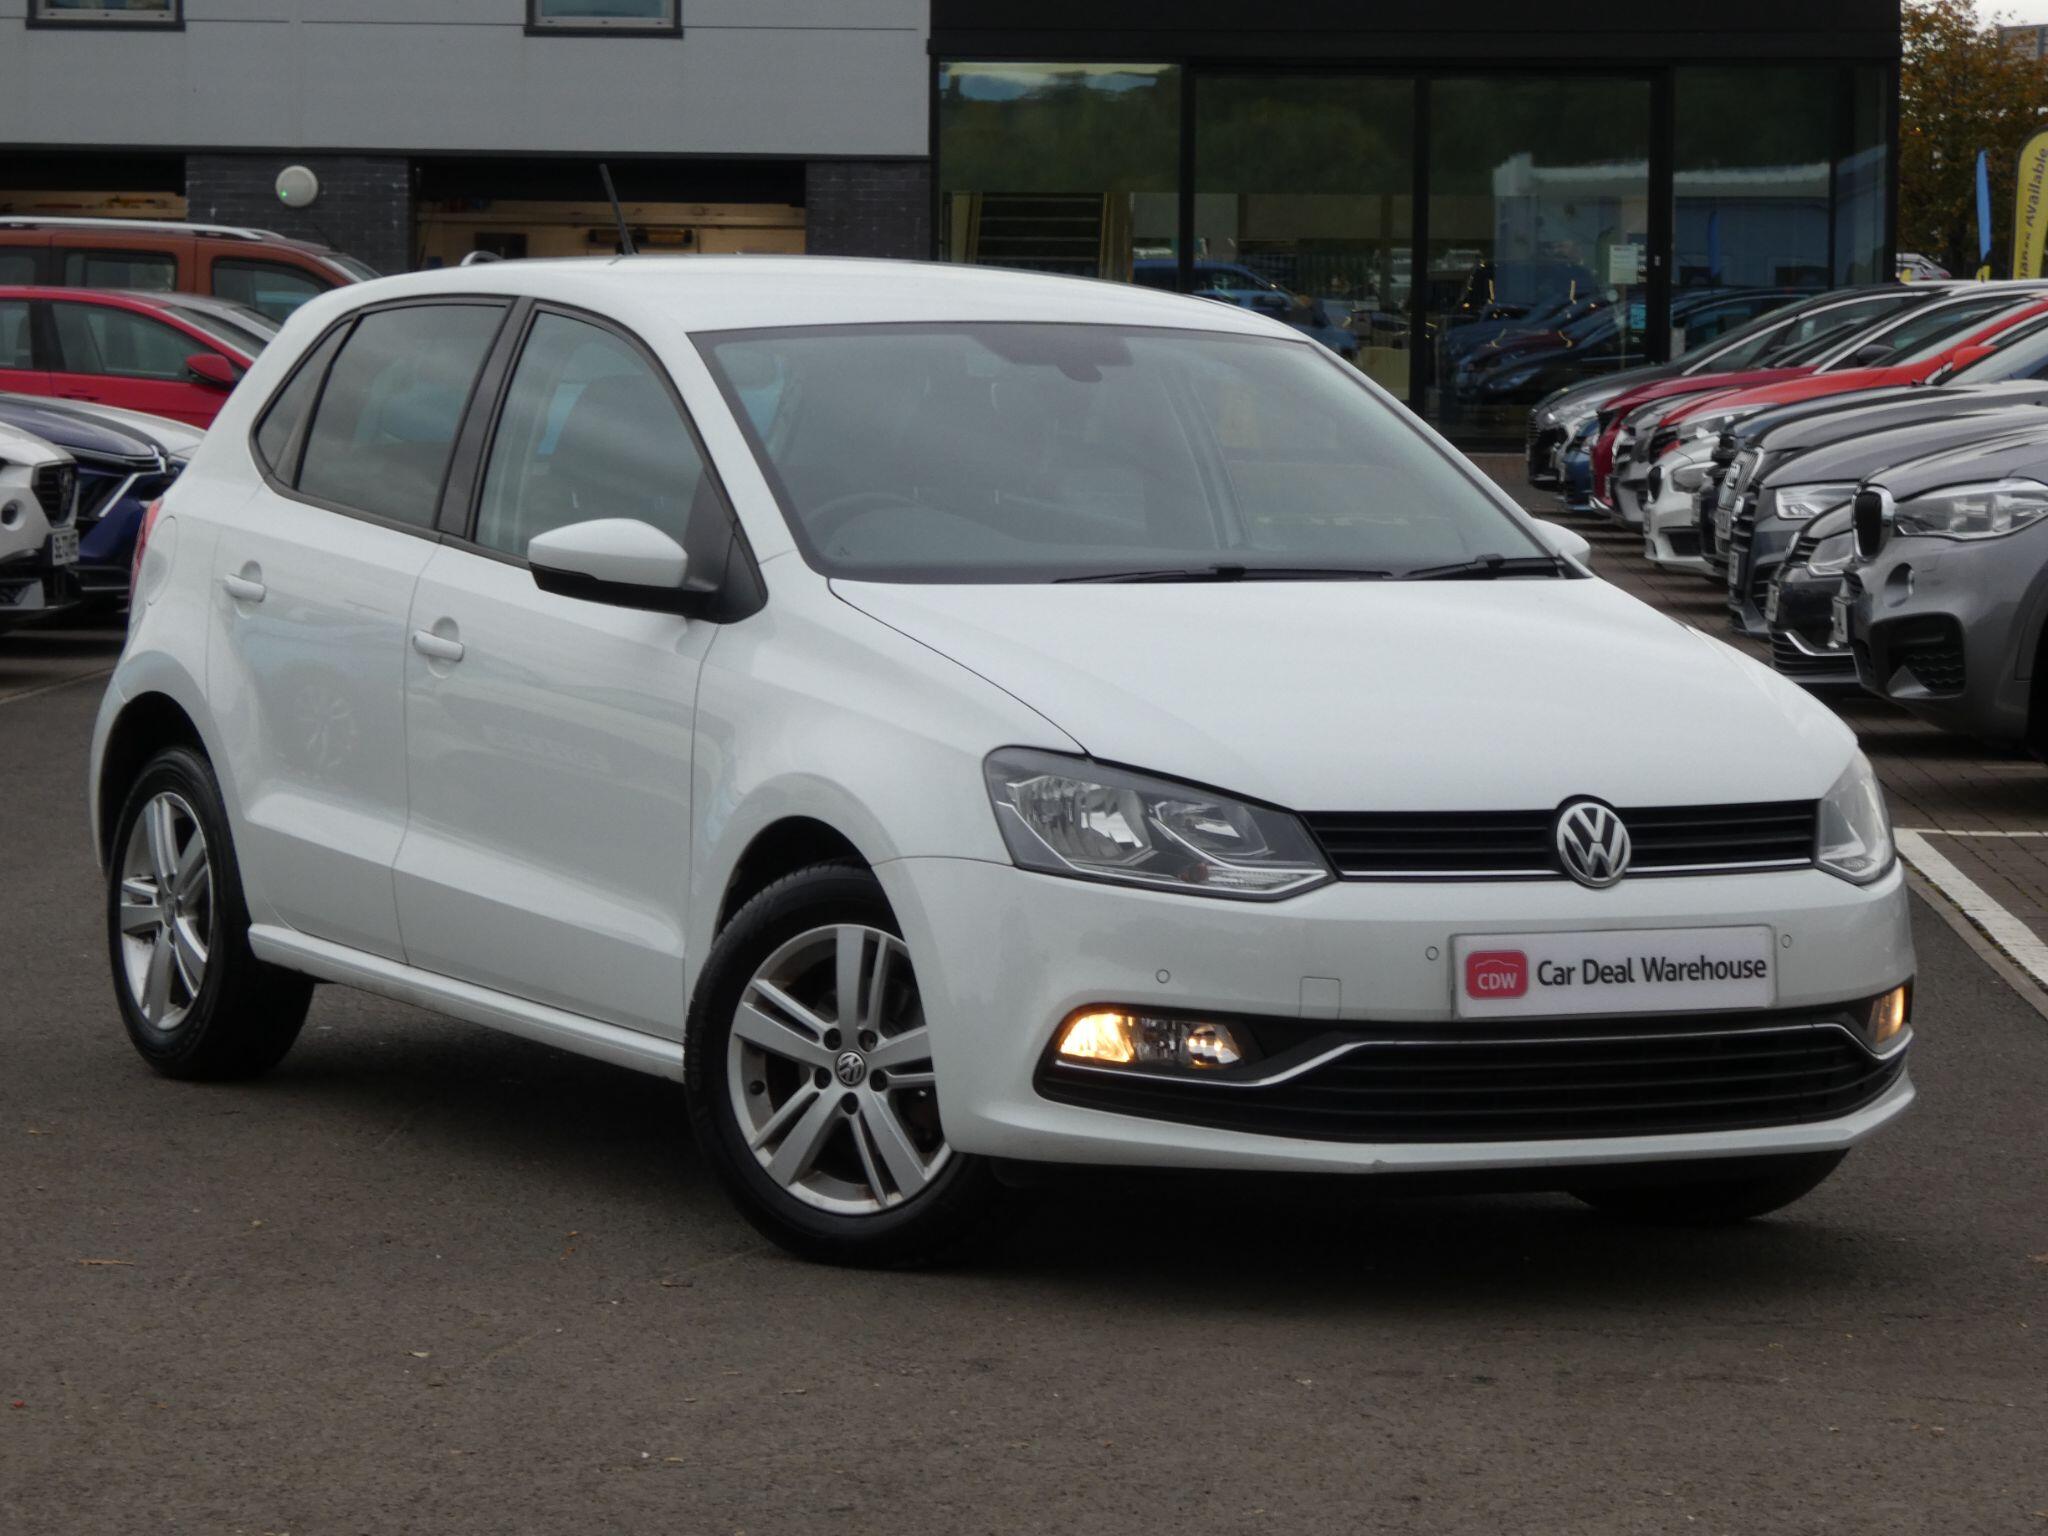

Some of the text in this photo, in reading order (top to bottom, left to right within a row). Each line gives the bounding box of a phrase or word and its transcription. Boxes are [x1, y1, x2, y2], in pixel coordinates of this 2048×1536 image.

[2027, 148, 2048, 227] Available
[1477, 972, 1517, 991] CDW
[1538, 954, 1767, 986] Car Deal Warehouse
